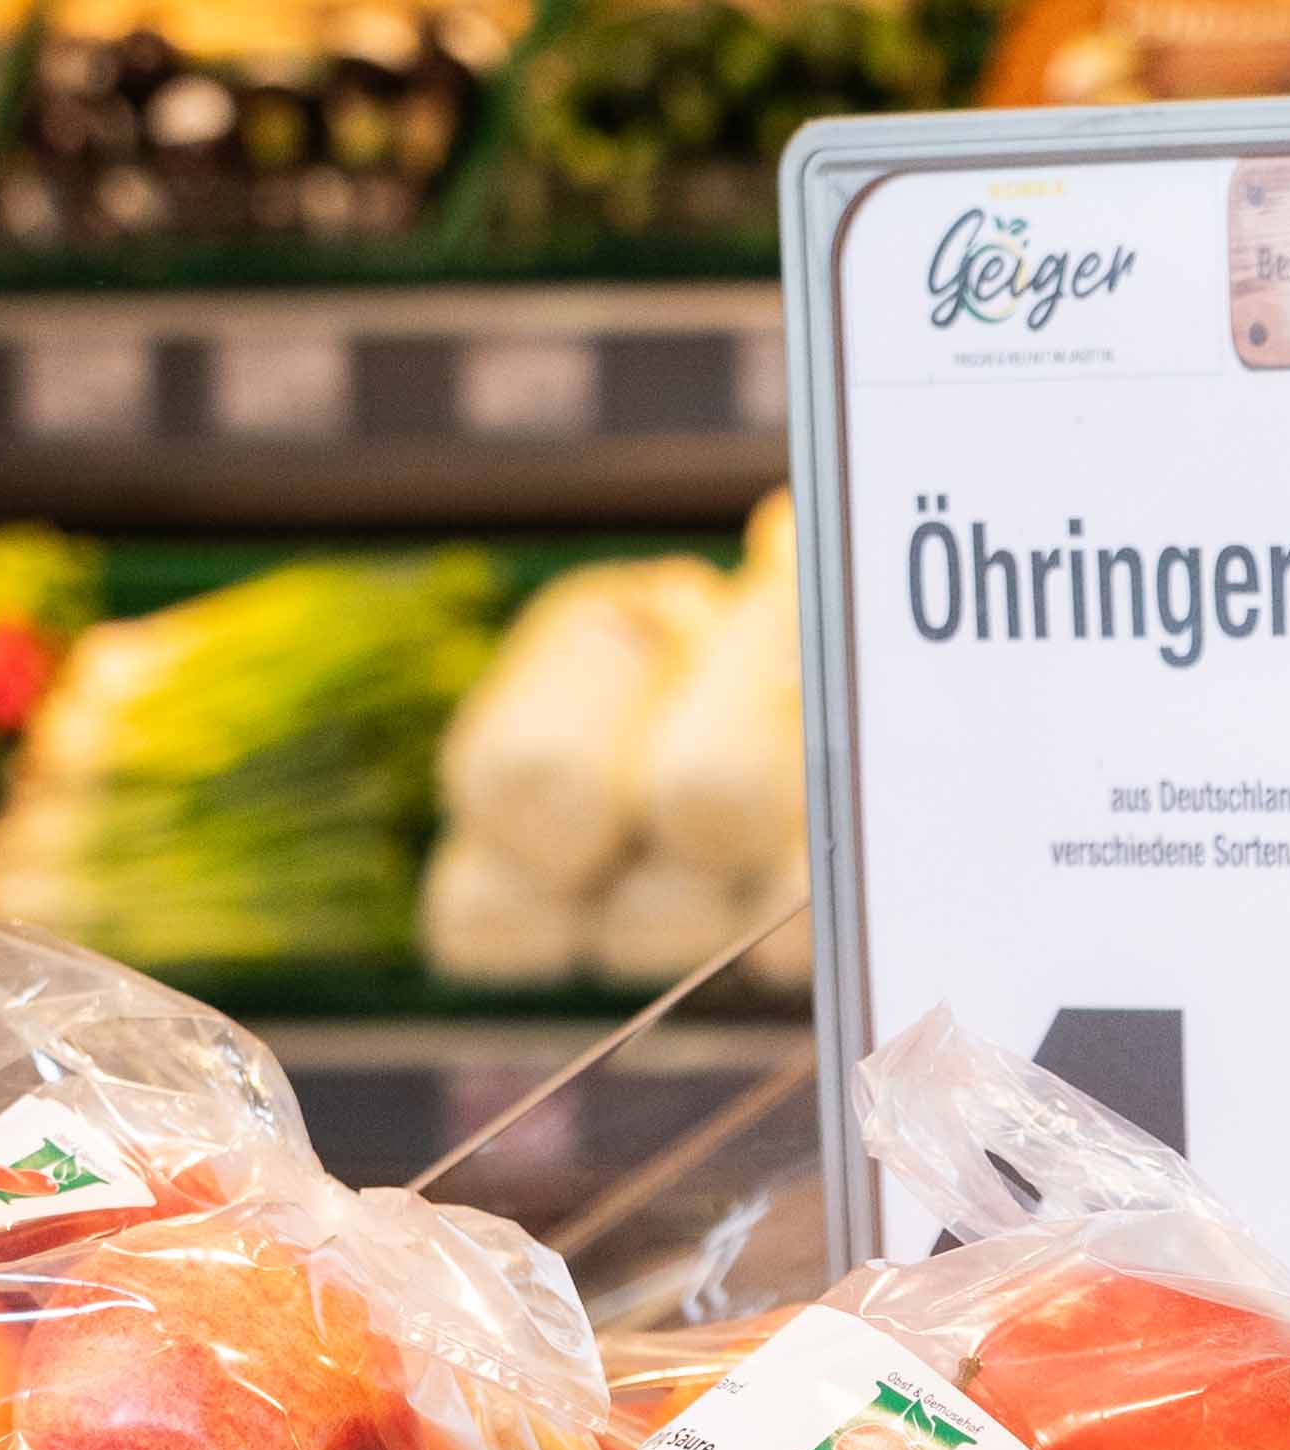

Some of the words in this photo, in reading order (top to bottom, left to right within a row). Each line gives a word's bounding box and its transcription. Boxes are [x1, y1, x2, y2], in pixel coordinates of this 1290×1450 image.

[928, 206, 1138, 331] Geiger
[1110, 787, 1151, 813] aus
[1050, 833, 1206, 868] verschiedene
